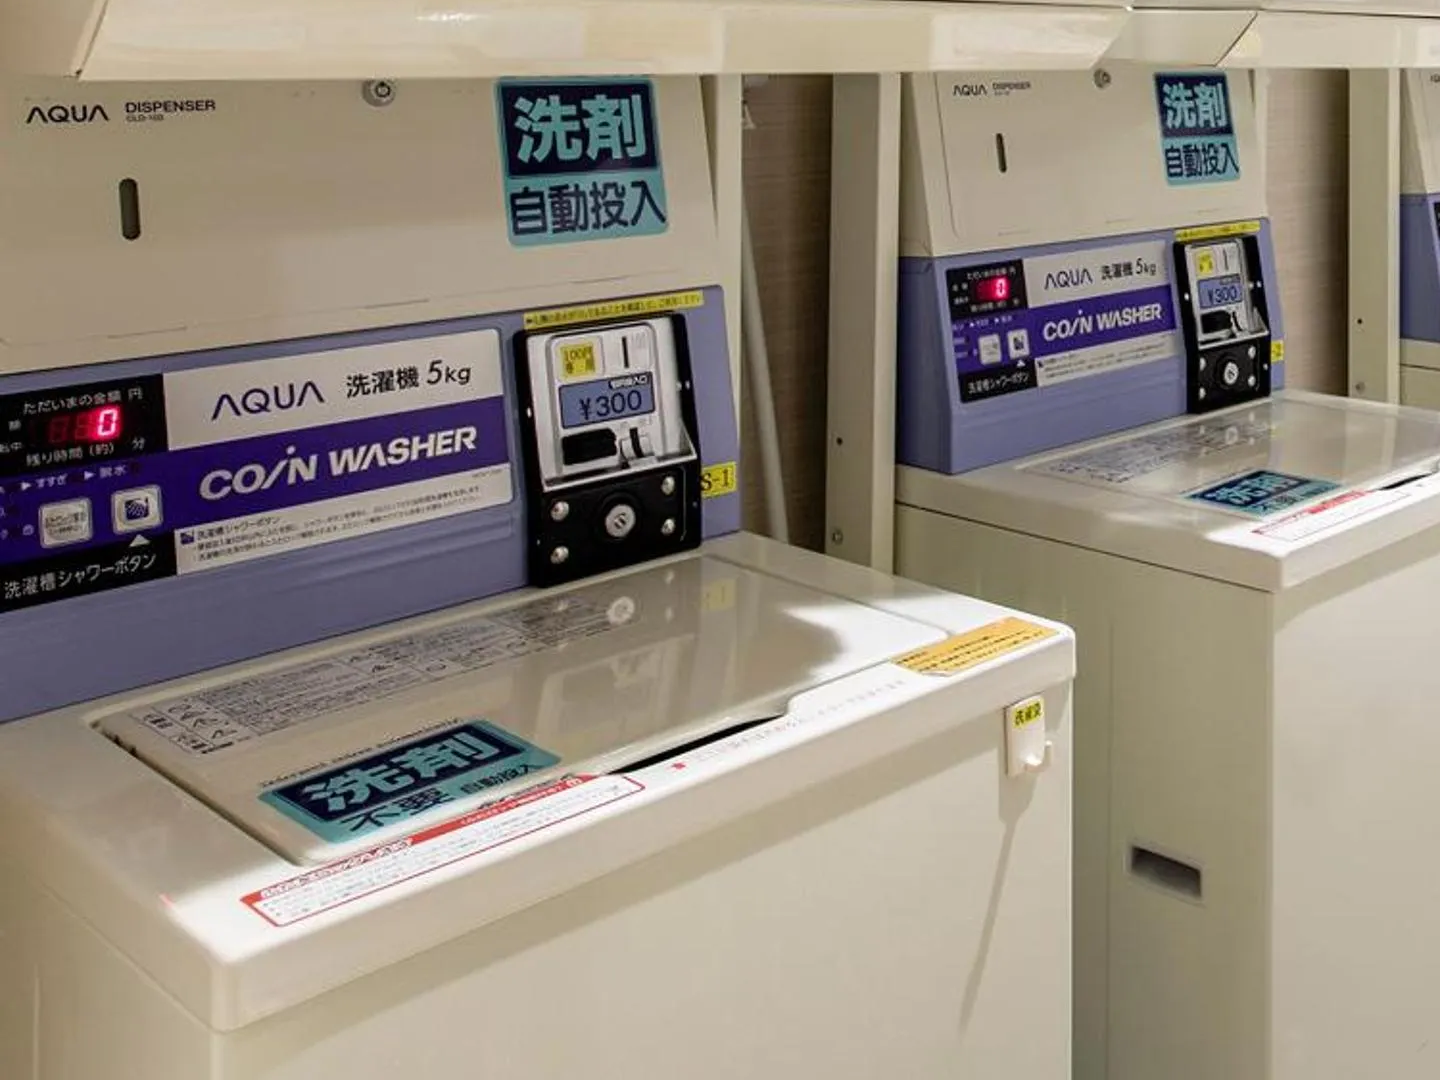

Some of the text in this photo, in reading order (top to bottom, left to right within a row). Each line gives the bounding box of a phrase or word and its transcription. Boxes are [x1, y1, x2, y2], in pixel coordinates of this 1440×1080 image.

[26, 98, 217, 125] AQUA DISPENSER
[953, 84, 988, 97] AQUA
[1162, 82, 1229, 129] 洗剤
[513, 94, 646, 164] 洗剤
[1164, 142, 1240, 179] 自動投入
[509, 178, 668, 238] 自動投入
[1043, 267, 1094, 291] AQUA
[1135, 257, 1157, 277] 5kg
[1043, 302, 1164, 342] COIN WASHER
[211, 358, 472, 421] AQUA 洗濯機 5kg
[579, 389, 643, 421] ¥300
[97, 407, 119, 437] 0
[199, 424, 478, 502] COIN WASHER
[701, 466, 732, 491] S-1
[4, 553, 157, 600] 洗濯槽シャワーボタン
[301, 730, 501, 813] 洗剤
[341, 786, 455, 834] 不要
